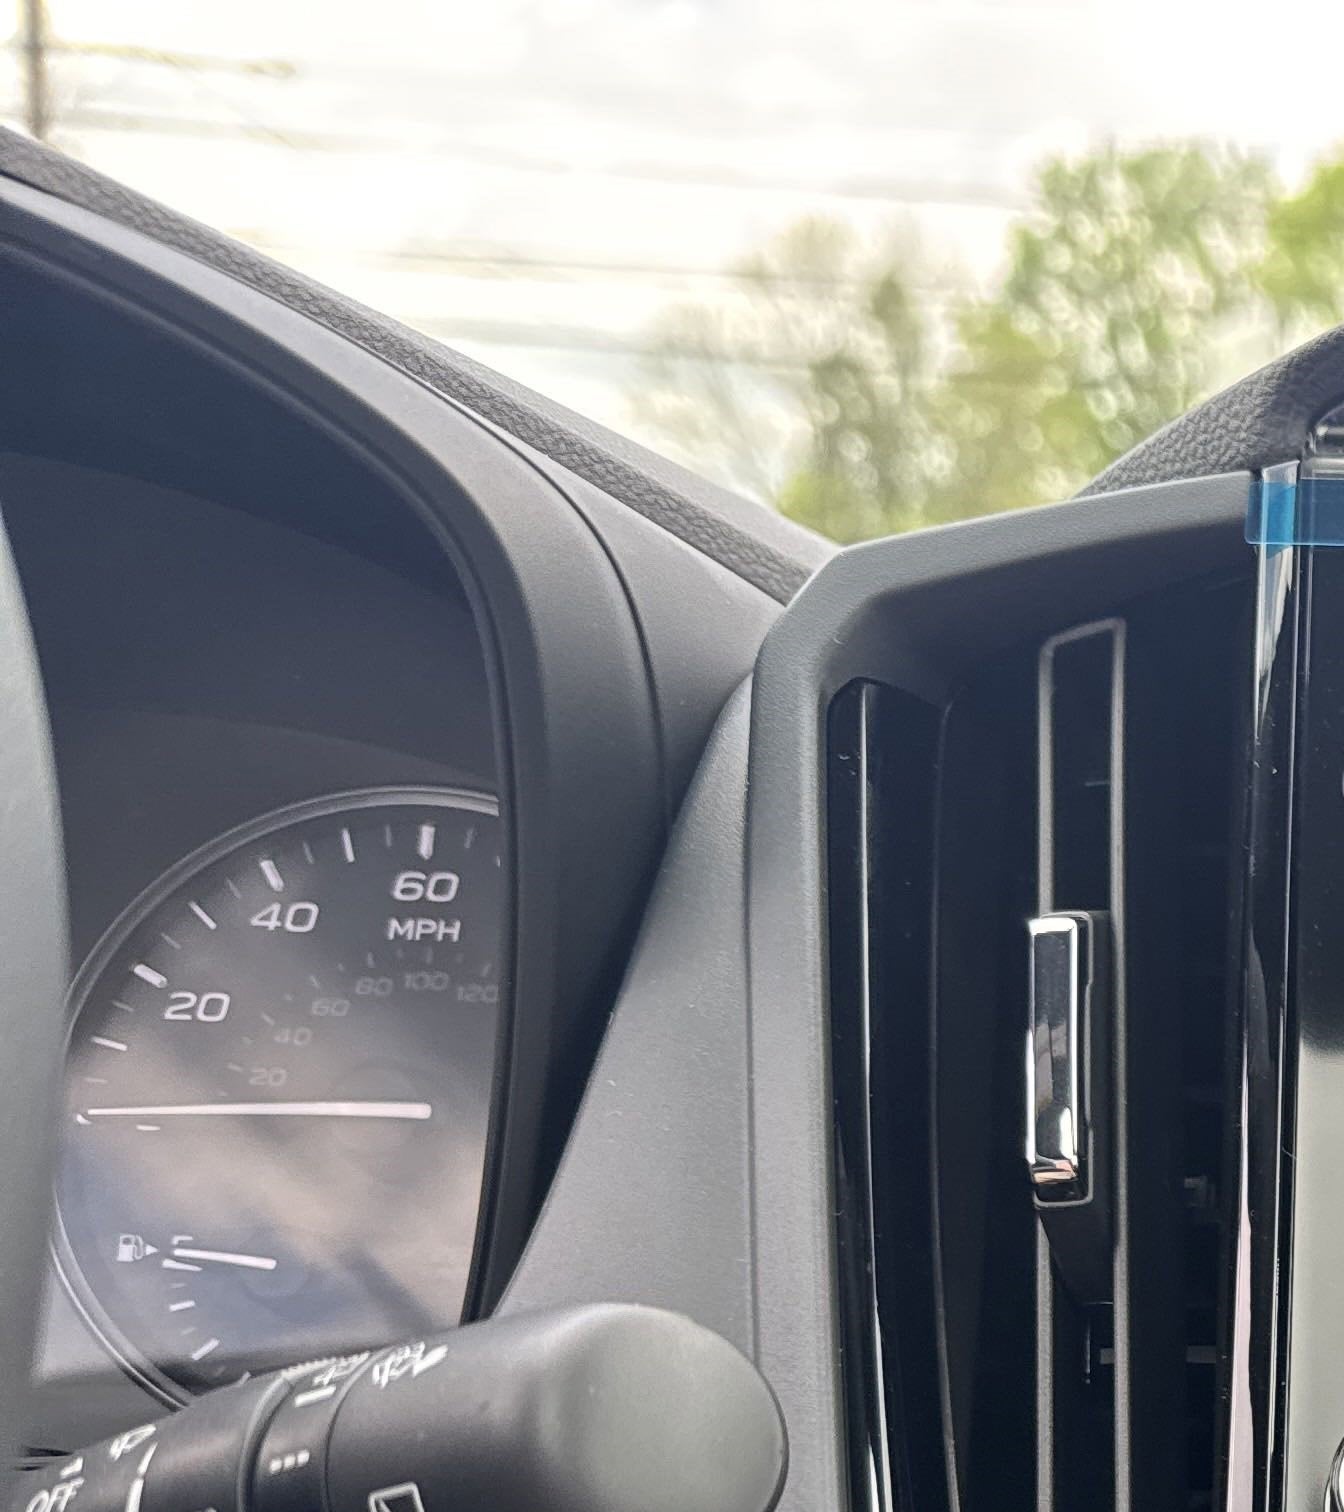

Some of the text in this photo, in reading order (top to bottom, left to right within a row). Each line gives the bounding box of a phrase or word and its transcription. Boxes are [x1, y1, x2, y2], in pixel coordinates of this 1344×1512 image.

[392, 871, 459, 902] 60
[250, 902, 319, 933] 40
[387, 919, 461, 942] MPH
[164, 991, 231, 1022] 20
